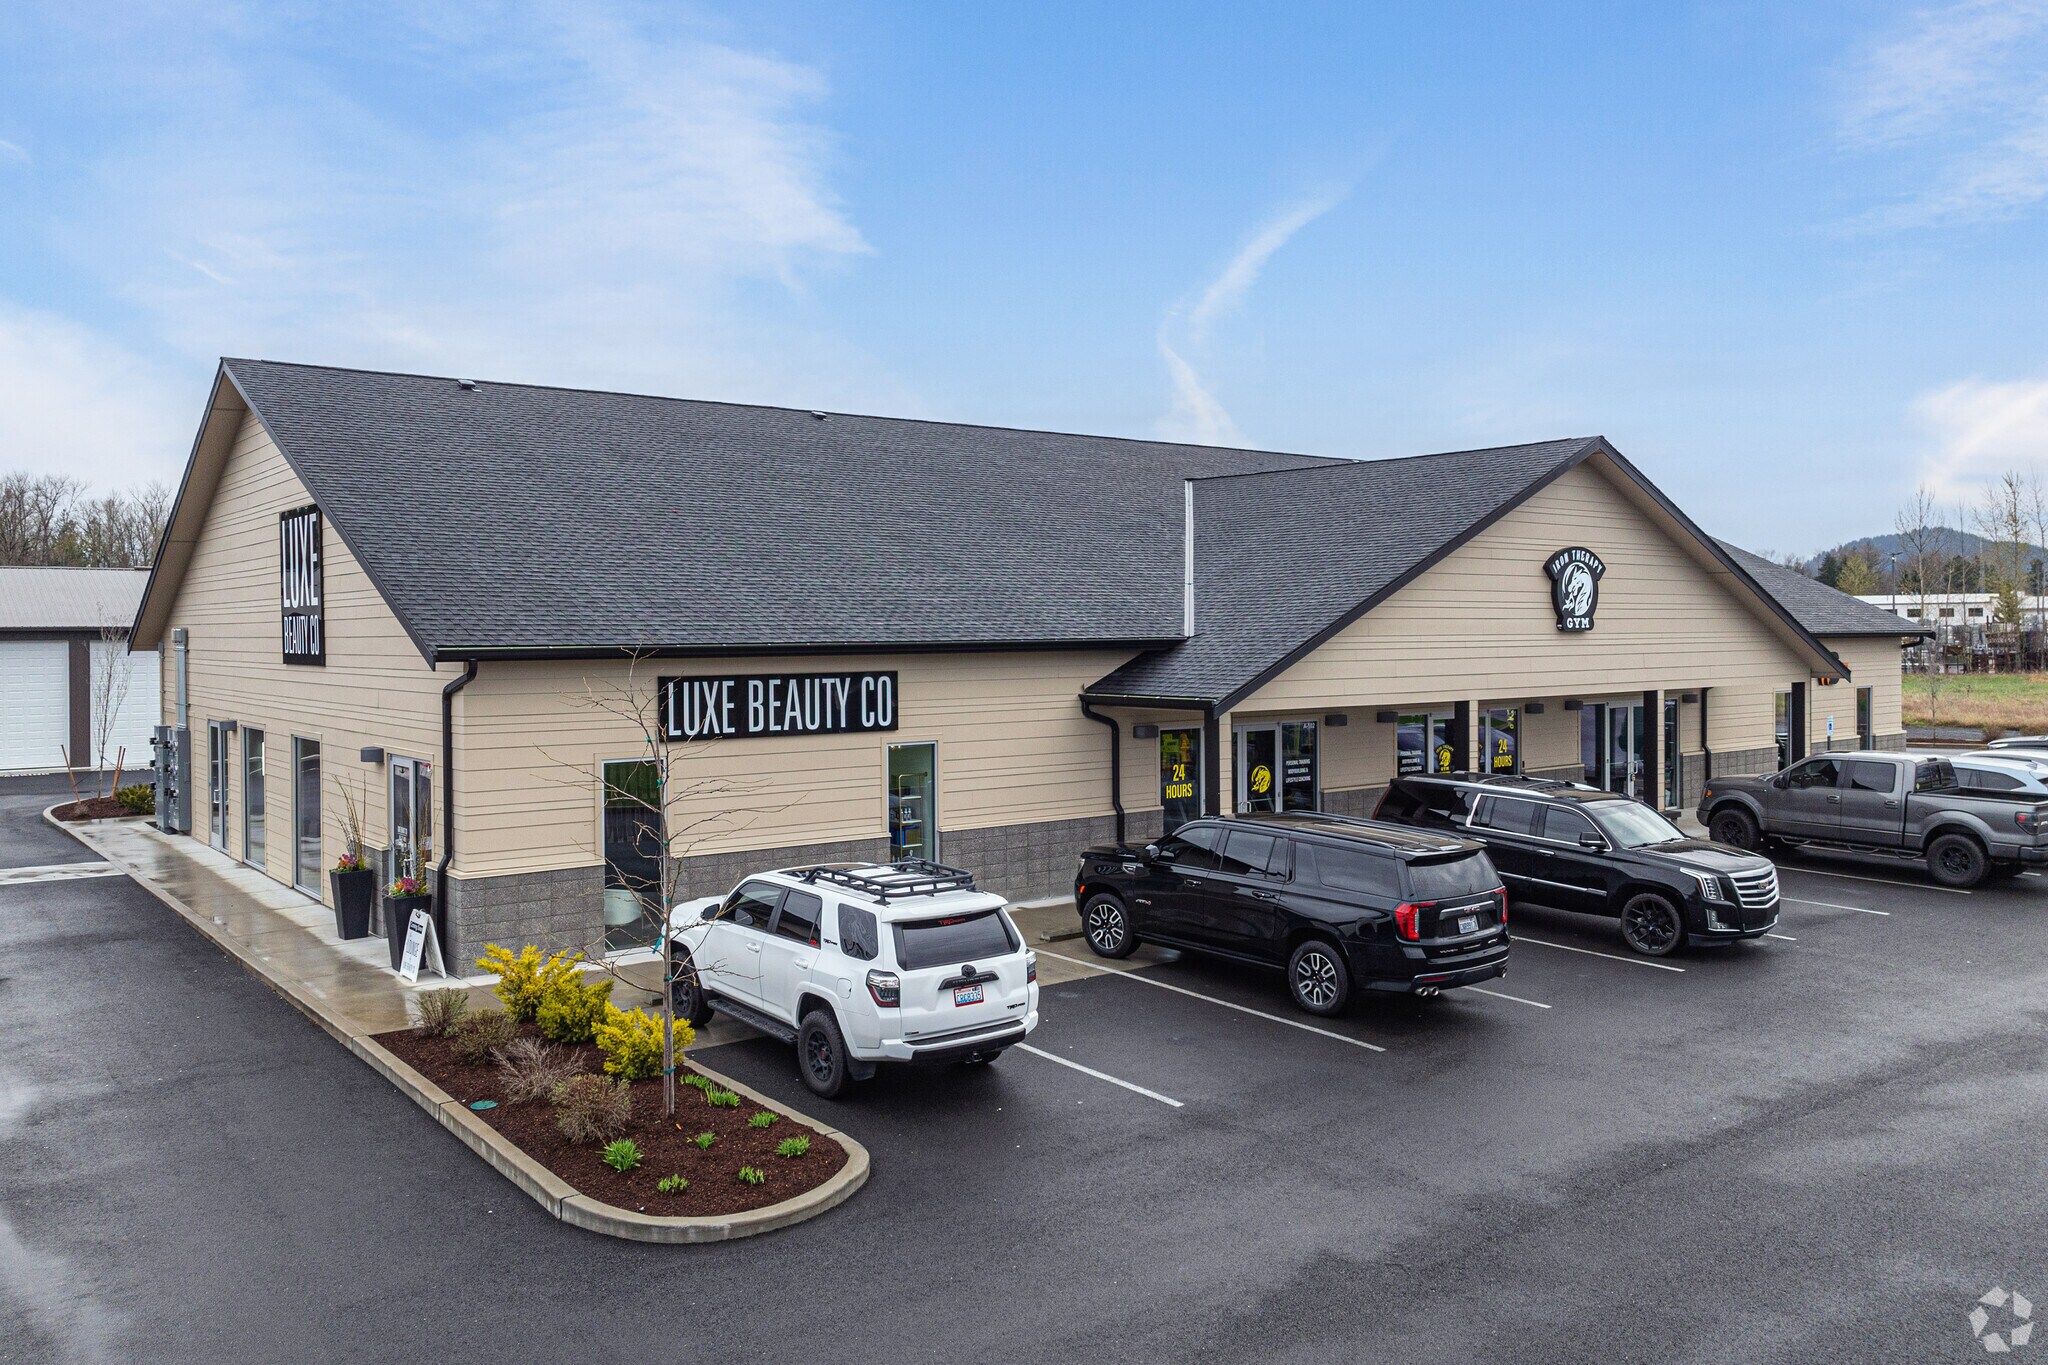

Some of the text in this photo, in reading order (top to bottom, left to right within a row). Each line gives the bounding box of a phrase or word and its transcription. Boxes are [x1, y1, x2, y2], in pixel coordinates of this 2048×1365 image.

[282, 513, 319, 609] LUXE
[1552, 549, 1603, 574] IRON THERAPY
[1566, 617, 1590, 629] GYM
[284, 614, 320, 655] BEAUTY CO
[668, 675, 892, 736] LUXE BEAUTY CO
[1498, 738, 1507, 754] 24
[1493, 754, 1513, 768] HOURS
[1172, 763, 1185, 782] 24
[1165, 783, 1193, 799] HOURS
